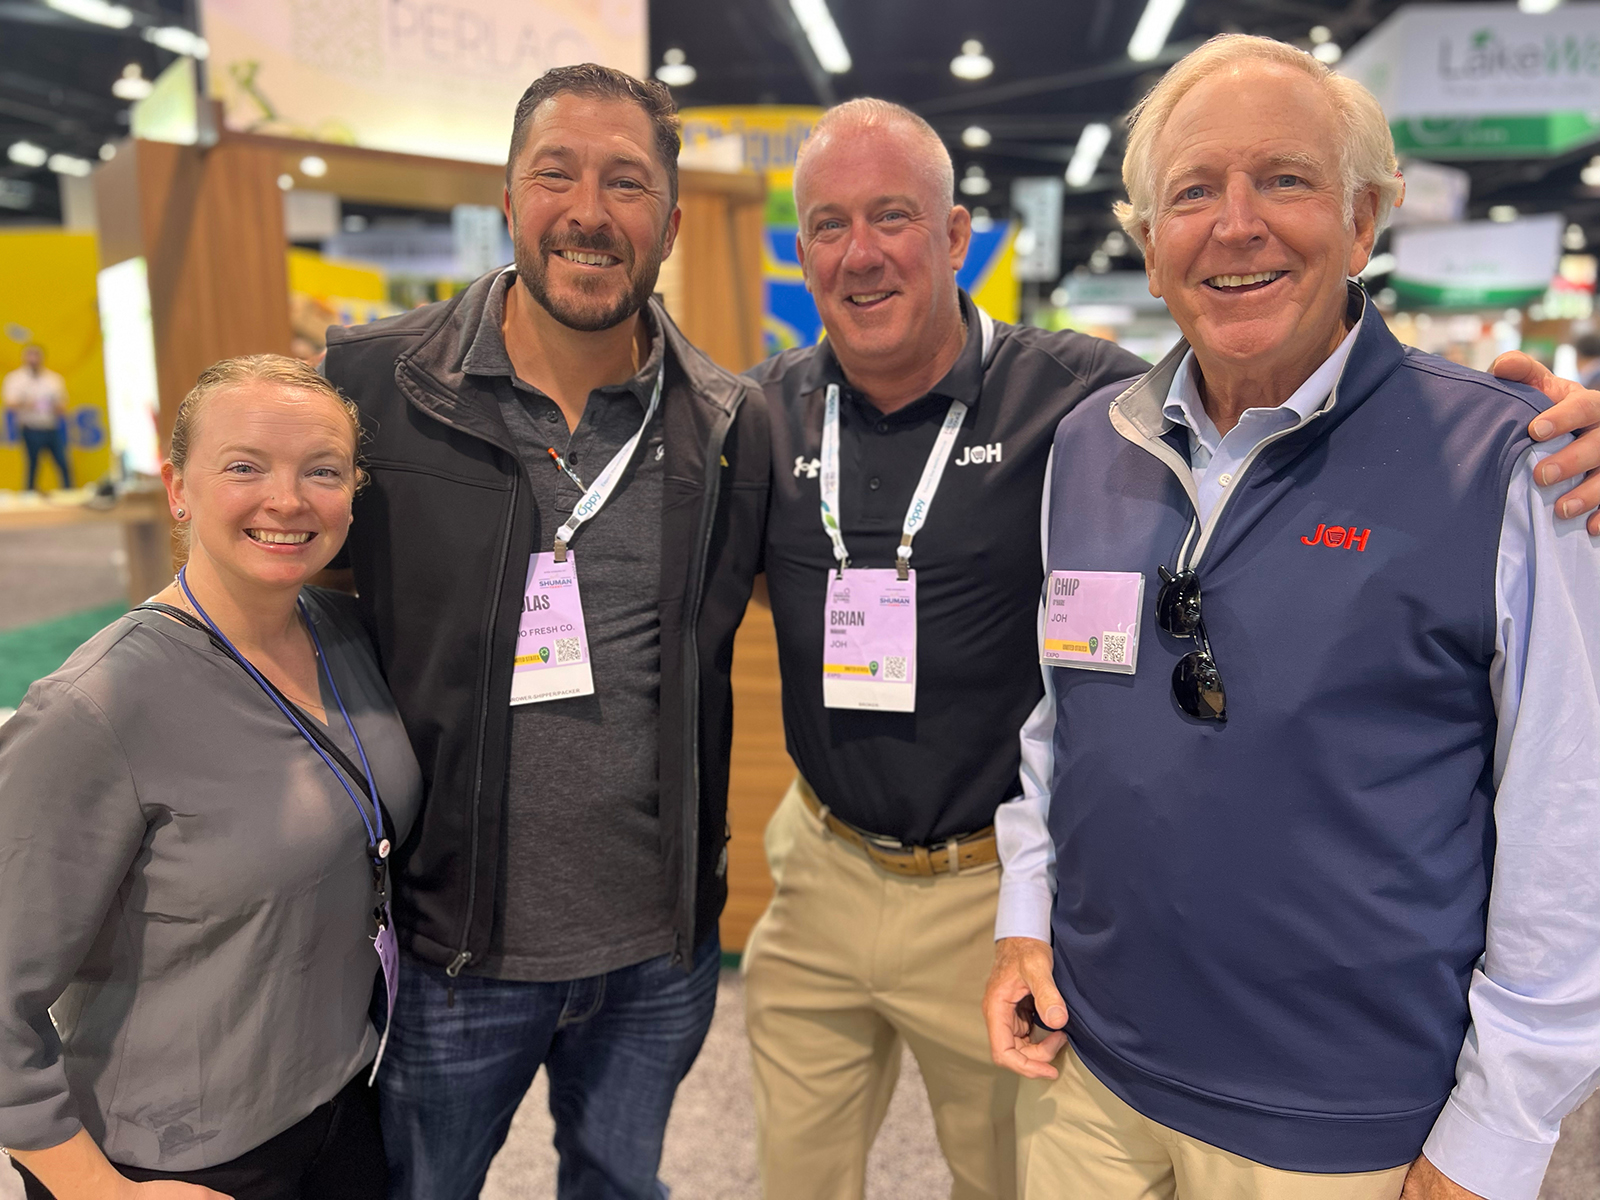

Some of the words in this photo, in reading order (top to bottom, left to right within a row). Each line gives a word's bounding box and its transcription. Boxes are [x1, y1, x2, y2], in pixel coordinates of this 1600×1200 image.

[955, 442, 1002, 466] JOH
[577, 490, 602, 517] Oppy
[907, 498, 926, 528] Oppy
[1301, 524, 1371, 552] JOH
[539, 578, 572, 587] SHUMAN
[1054, 578, 1080, 596] CHIP
[522, 594, 550, 612] LAS
[830, 610, 865, 626] BRIAN
[1051, 613, 1067, 623] JOH
[529, 625, 558, 636] FRESH
[560, 623, 575, 632] CO.
[830, 640, 847, 648] JOH
